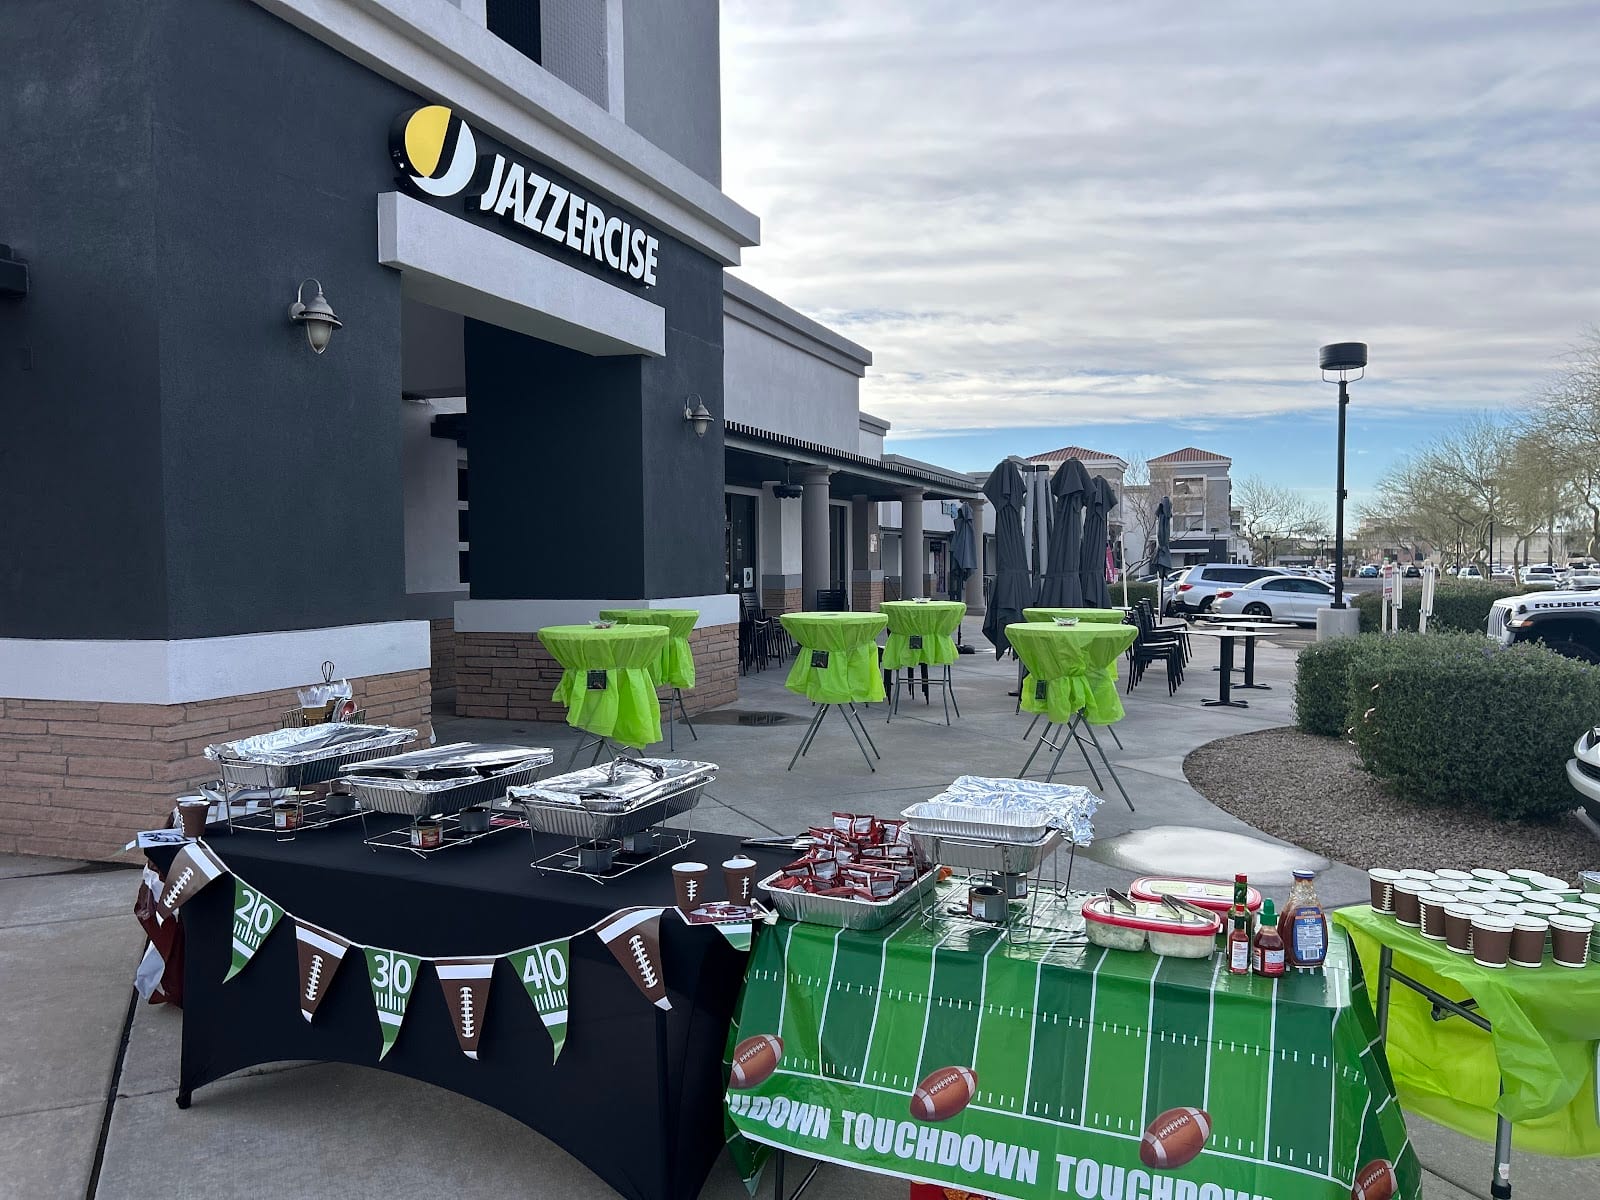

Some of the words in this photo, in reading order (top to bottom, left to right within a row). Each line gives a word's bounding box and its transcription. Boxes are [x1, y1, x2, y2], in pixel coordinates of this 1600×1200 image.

[480, 153, 659, 287] JAZZERCISE
[235, 889, 273, 934] 20
[372, 953, 412, 995] 30
[523, 947, 567, 989] 40
[842, 1109, 1040, 1185] TOUCHDOWN
[1056, 1153, 1274, 1200] TOUCHD
